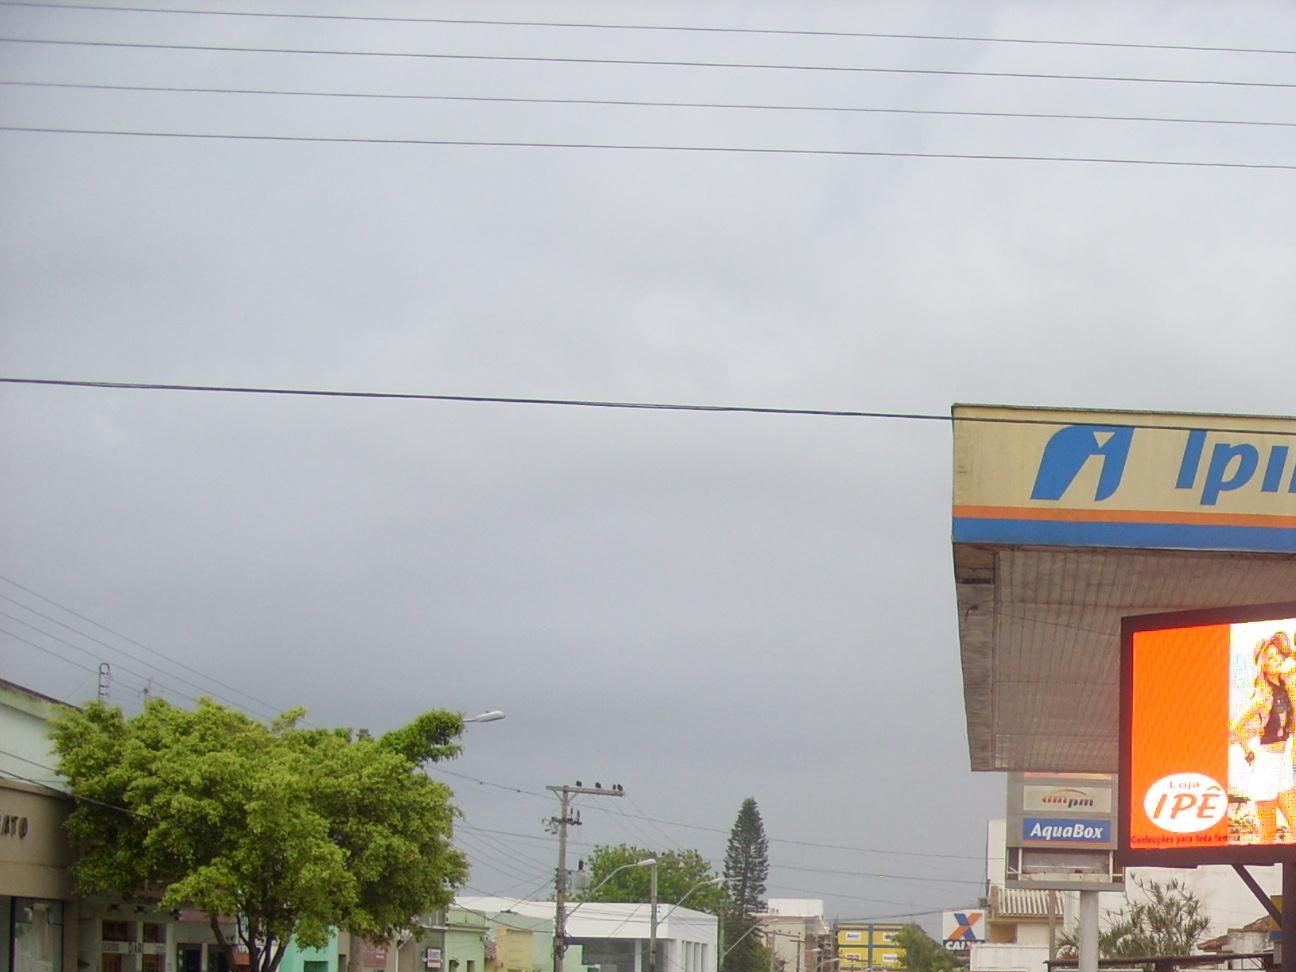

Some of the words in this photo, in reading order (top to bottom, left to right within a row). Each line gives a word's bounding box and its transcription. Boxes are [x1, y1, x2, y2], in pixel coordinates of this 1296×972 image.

[1169, 780, 1200, 790] Loja
[1153, 785, 1221, 819] IPÊ
[1030, 822, 1104, 841] AquaBox
[945, 941, 982, 951] CAIX
